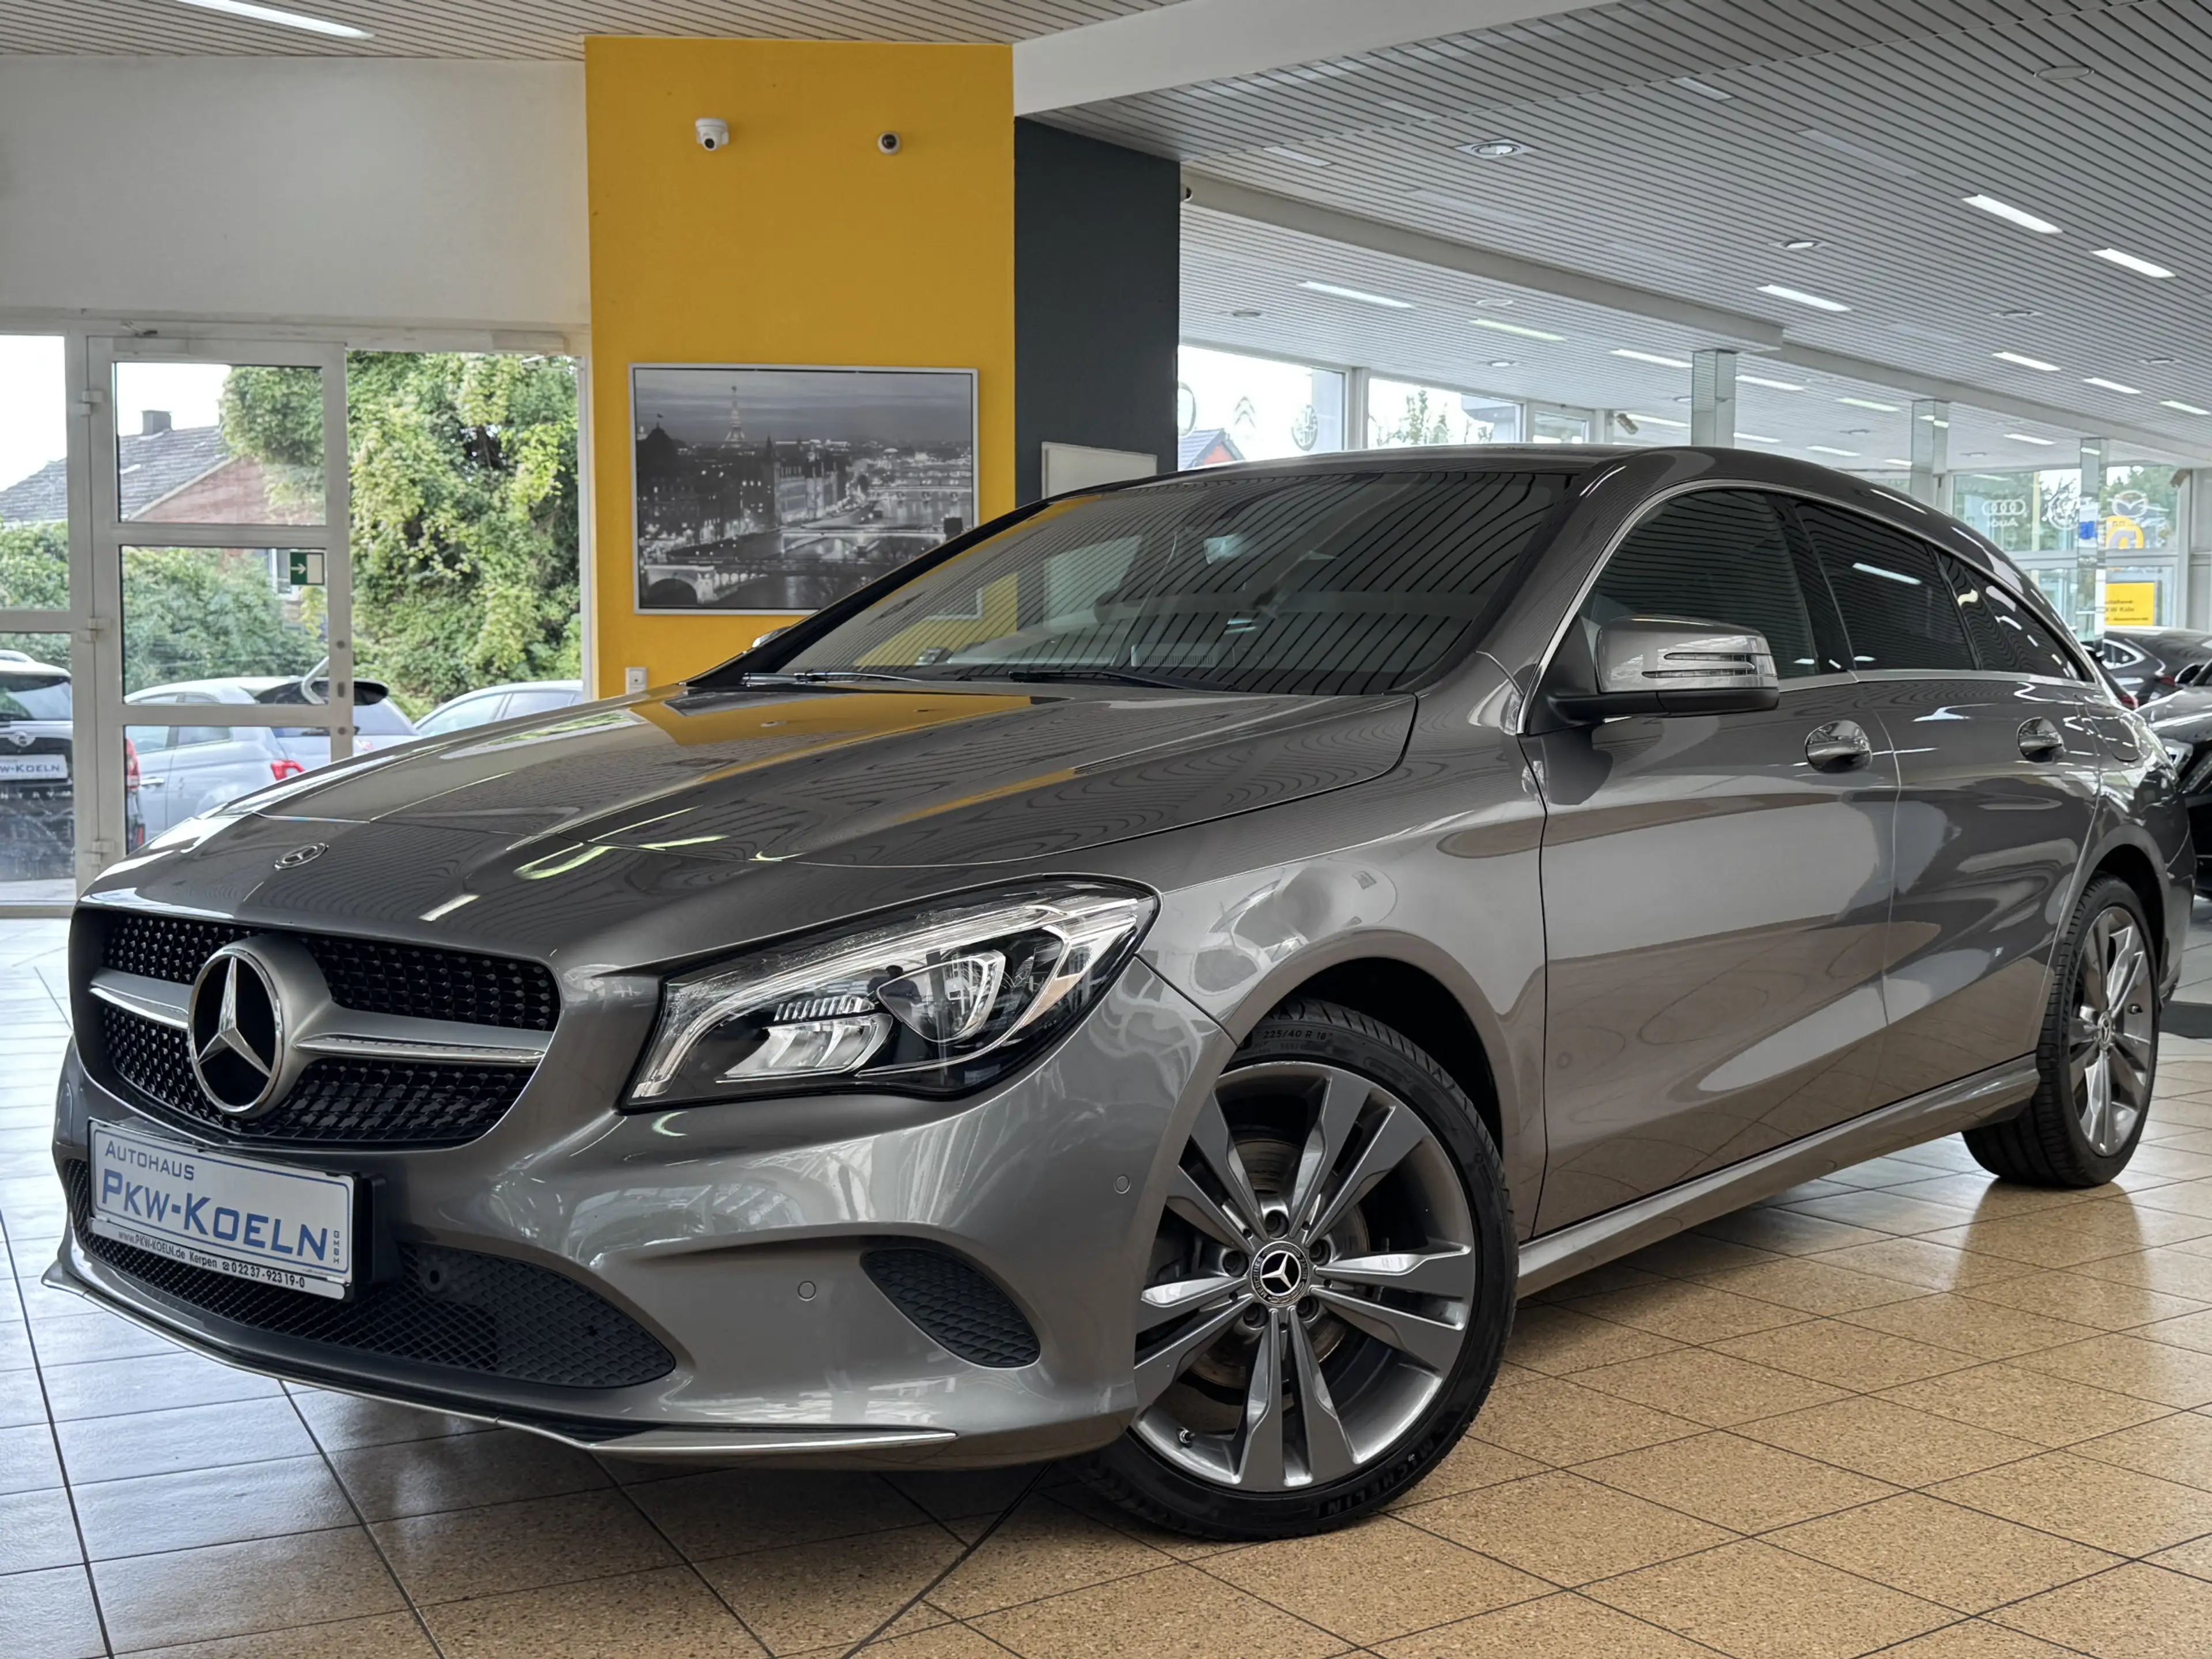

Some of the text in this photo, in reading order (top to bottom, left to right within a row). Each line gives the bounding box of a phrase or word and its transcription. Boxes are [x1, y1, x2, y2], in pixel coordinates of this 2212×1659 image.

[105, 1140, 195, 1181] AUTOHAUS
[102, 1168, 328, 1261] PKW-KOELN
[190, 1251, 217, 1268] Kerpen
